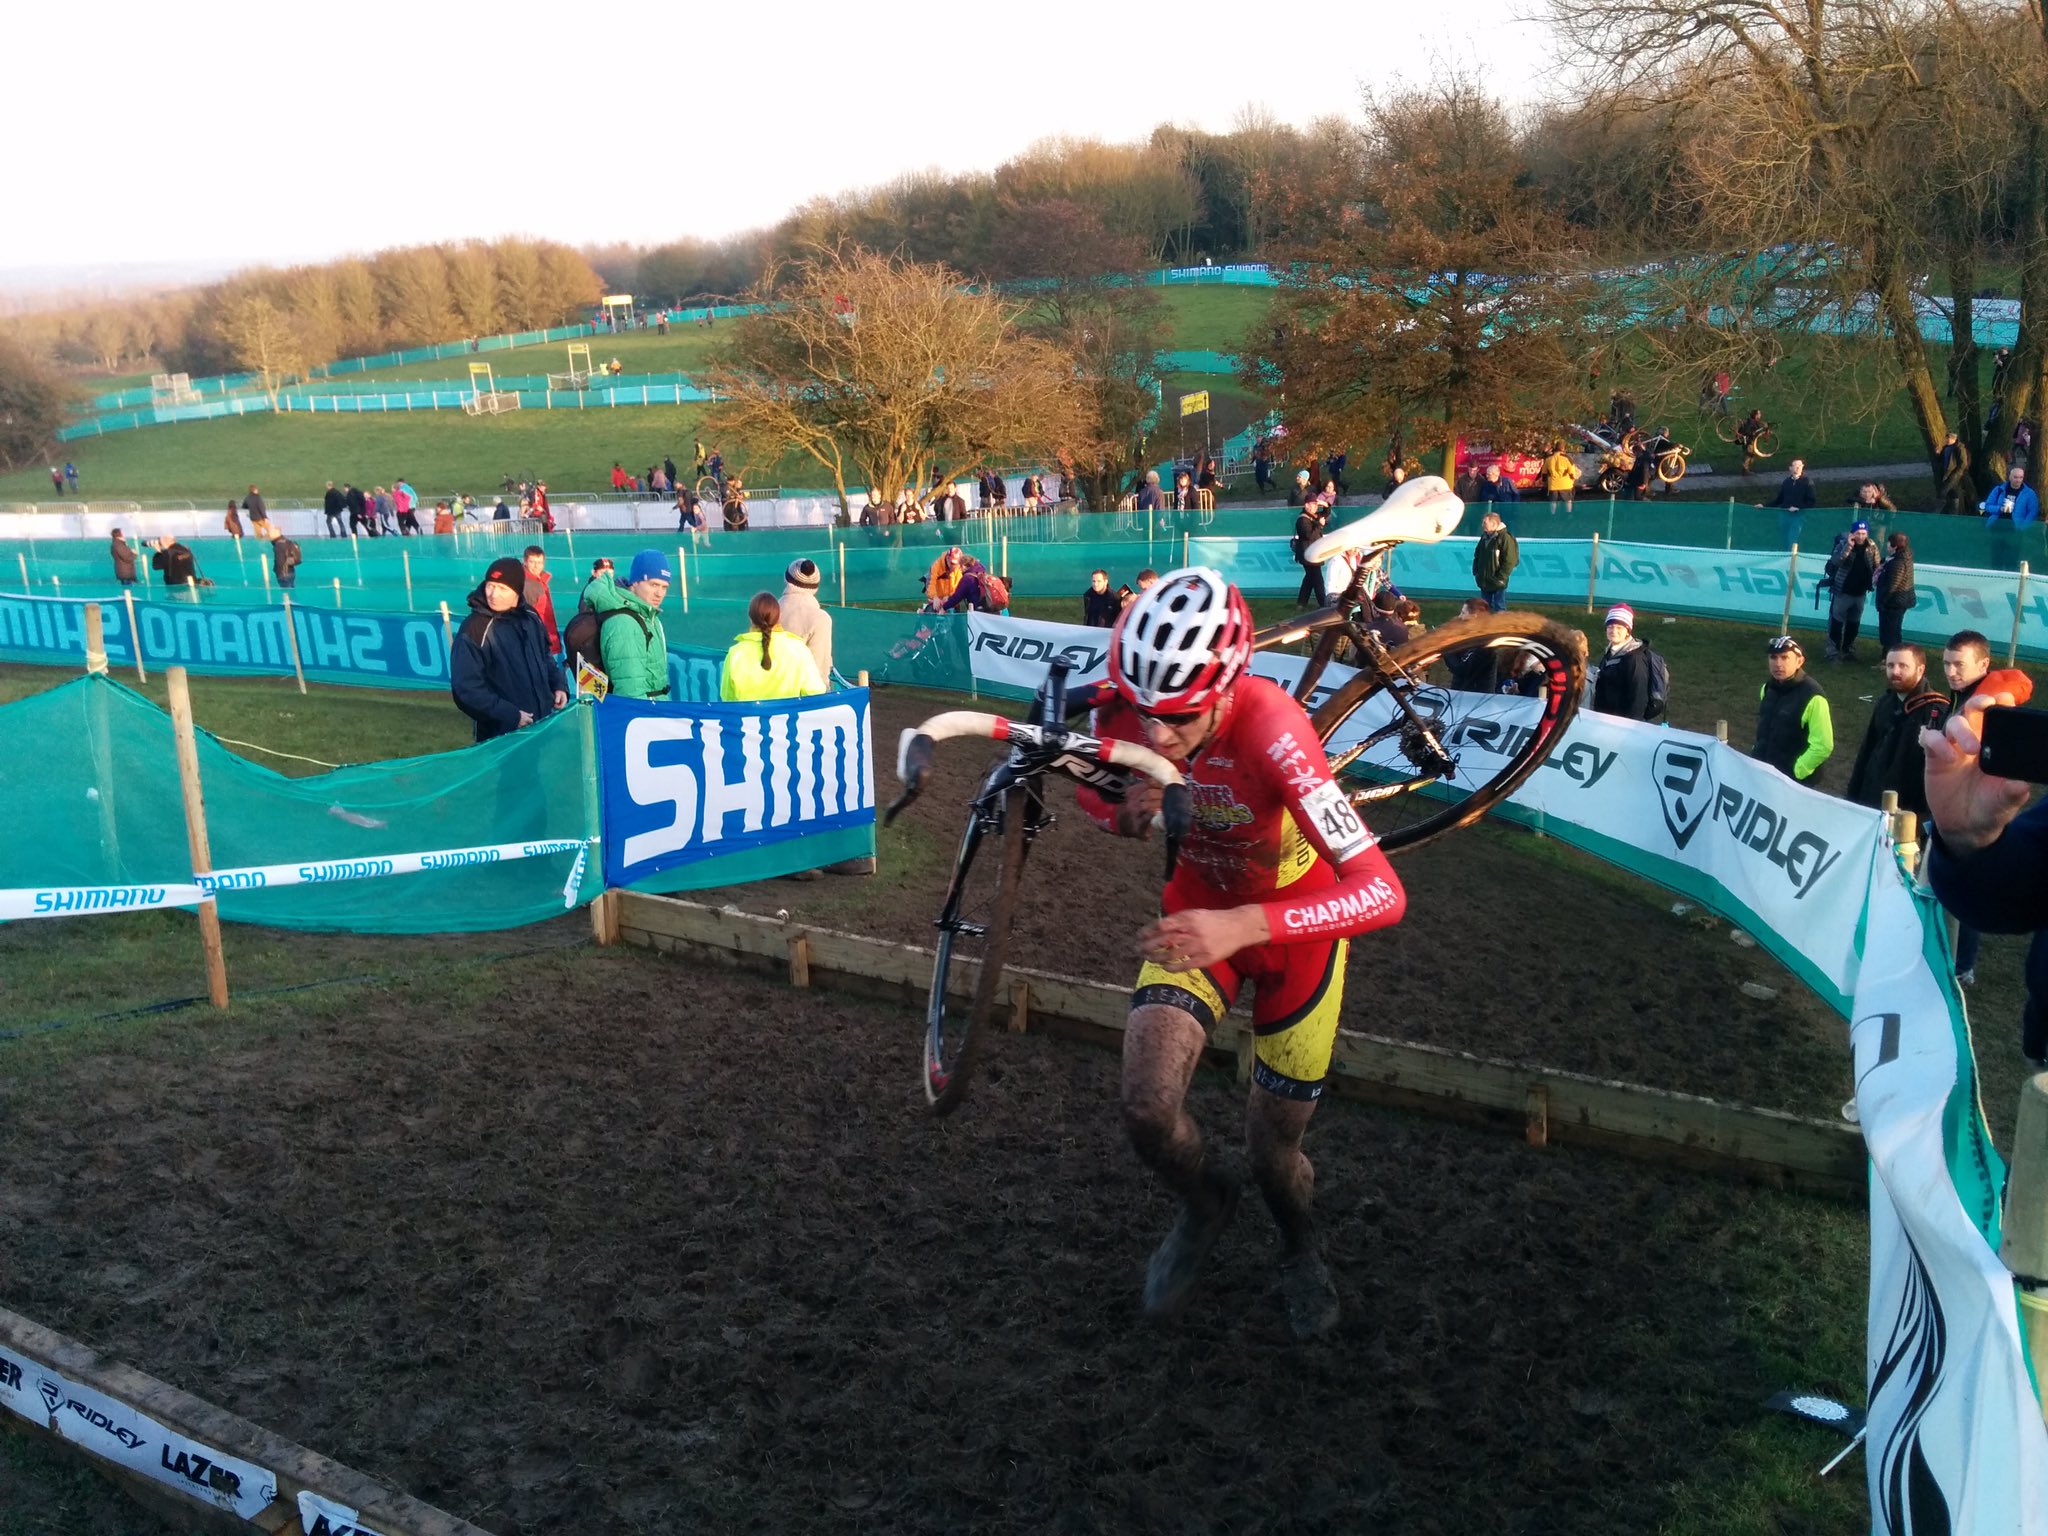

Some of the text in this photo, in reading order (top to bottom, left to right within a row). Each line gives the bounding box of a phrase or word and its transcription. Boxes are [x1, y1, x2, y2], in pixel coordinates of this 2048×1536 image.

[1171, 266, 1221, 279] SHIMANO
[975, 631, 1110, 675] RIDLEY
[1049, 754, 1127, 794] RID
[1322, 800, 1359, 840] 48
[1713, 782, 1842, 899] RIDLEY
[1284, 877, 1393, 929] CHAPMANS
[1358, 893, 1399, 922] COMPANY
[66, 1399, 147, 1449] RIDLEY
[161, 1443, 243, 1499] LAZER
